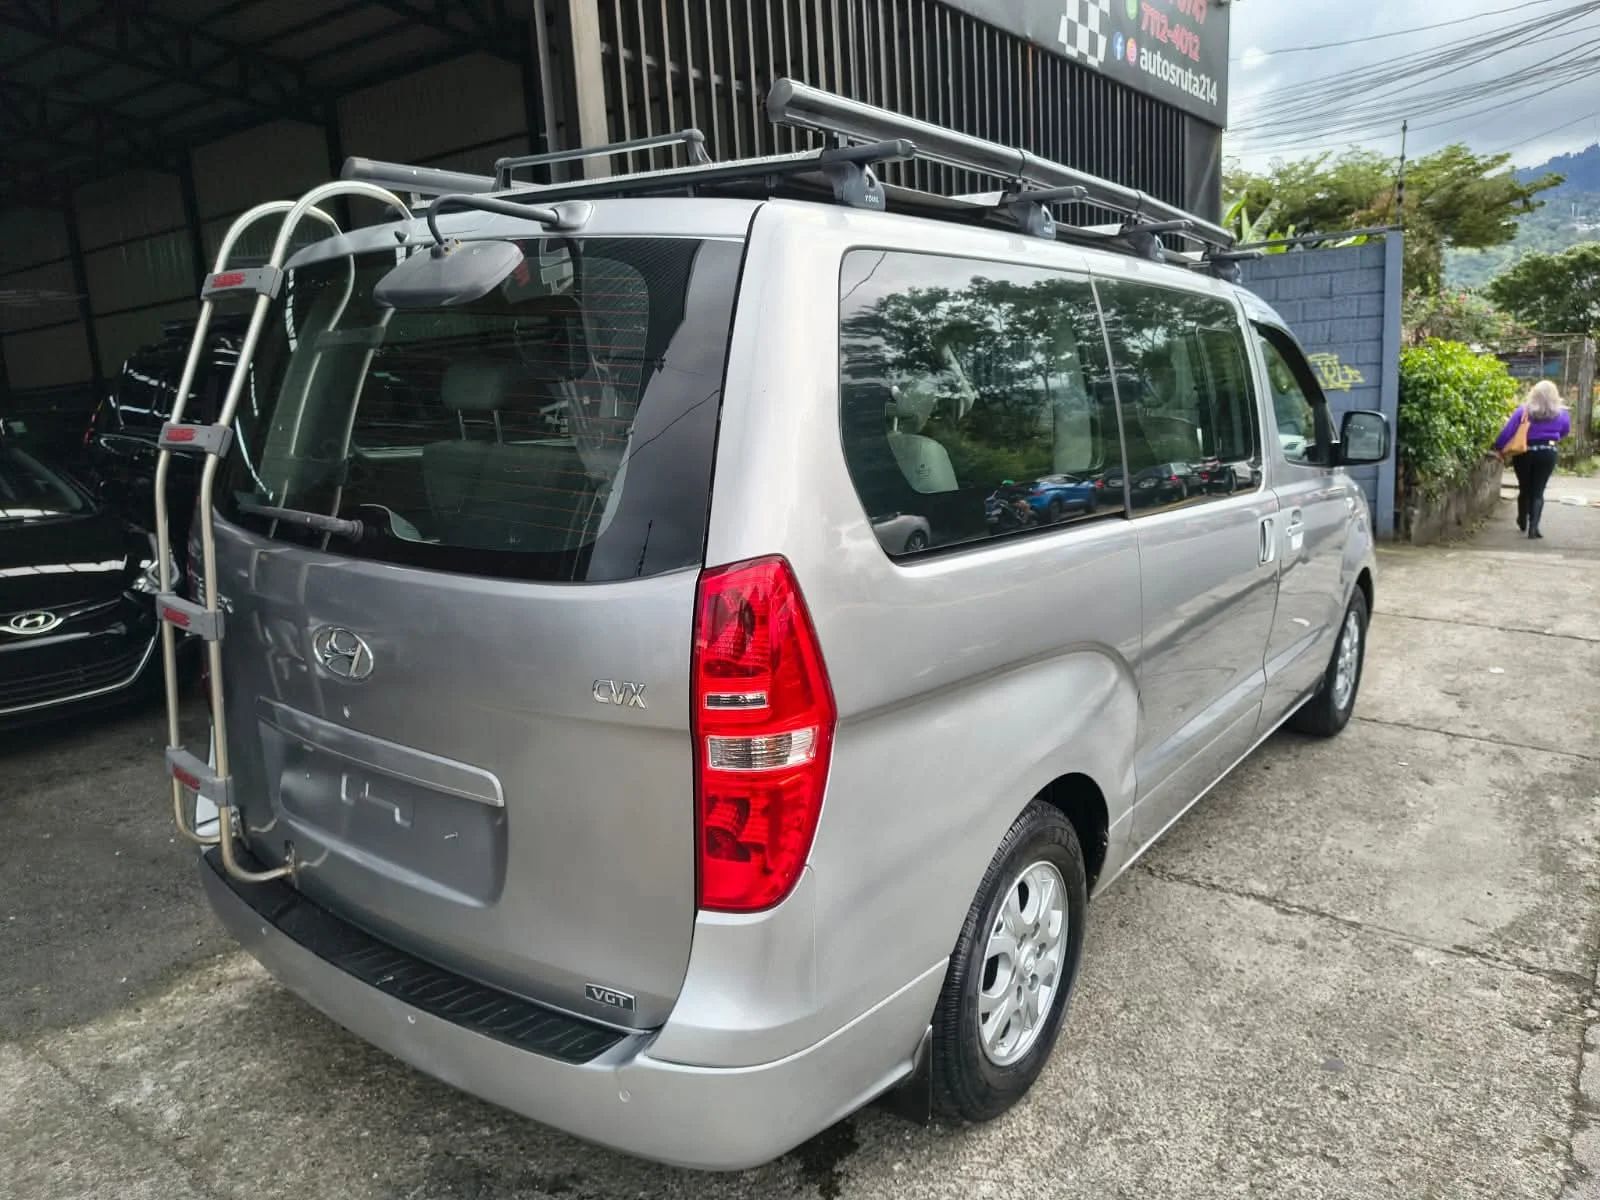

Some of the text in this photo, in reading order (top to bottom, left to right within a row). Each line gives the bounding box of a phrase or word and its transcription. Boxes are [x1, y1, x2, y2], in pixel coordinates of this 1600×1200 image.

[1140, 47, 1217, 107] autosruta214
[592, 679, 648, 710] CVX
[591, 987, 628, 1008] VGT
